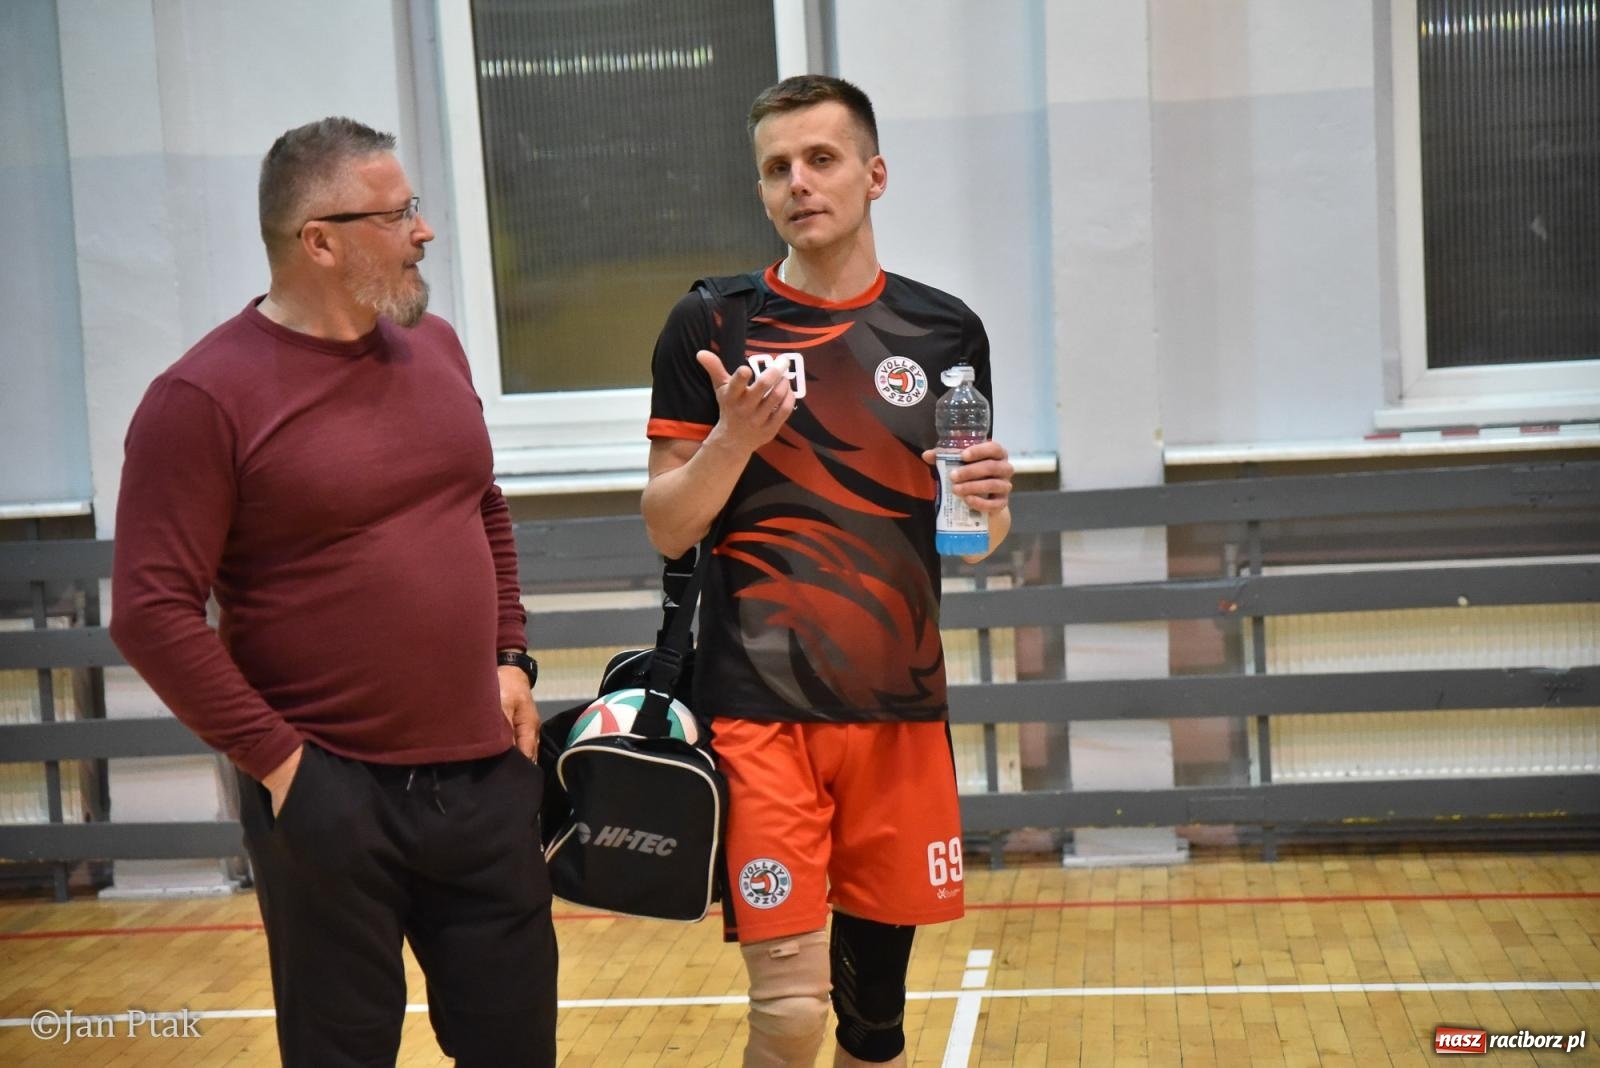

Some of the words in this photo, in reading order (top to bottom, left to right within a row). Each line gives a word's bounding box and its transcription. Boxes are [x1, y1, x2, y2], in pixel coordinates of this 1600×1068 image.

[880, 360, 922, 378] VOLLEY
[882, 386, 921, 403] PSZÓW
[593, 825, 678, 857] HI-TEC
[743, 861, 785, 879] VOLLEY
[927, 836, 963, 887] 69
